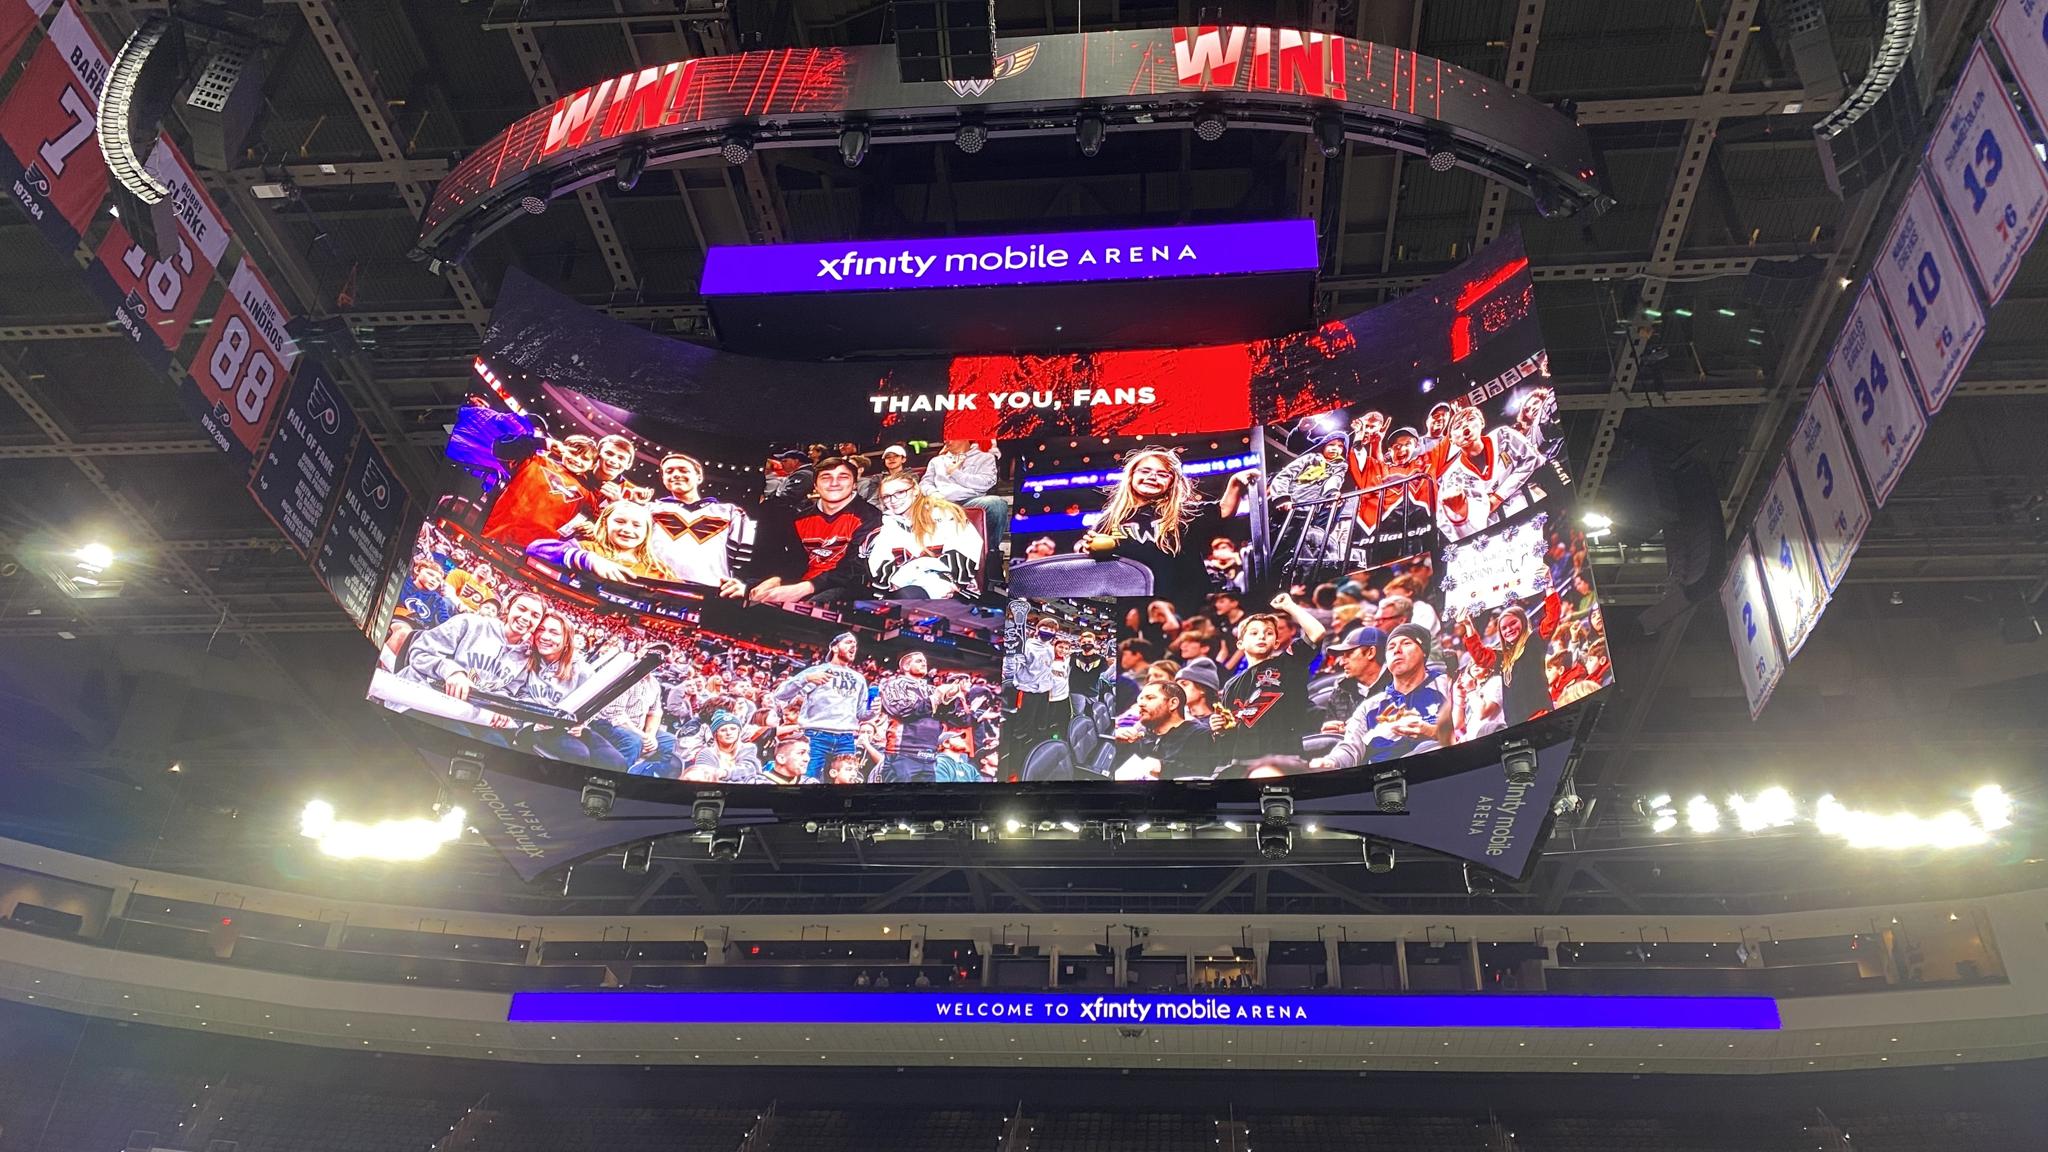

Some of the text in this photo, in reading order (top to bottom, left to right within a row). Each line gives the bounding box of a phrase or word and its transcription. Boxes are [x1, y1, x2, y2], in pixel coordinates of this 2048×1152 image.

[71, 45, 105, 99] BARB
[94, 58, 106, 81] BIL
[1172, 25, 1348, 102] WIN!
[543, 58, 699, 155] WIN!
[39, 82, 98, 176] 7
[1963, 128, 2003, 215] 13
[181, 182, 203, 213] BOBBY
[1996, 202, 2017, 242] 76
[817, 245, 1196, 280] xfinity mobile ARENA
[262, 299, 277, 321] ERIC
[1907, 251, 1941, 330] 10
[242, 290, 284, 353] LINDROS
[1935, 325, 1952, 359] 76
[210, 314, 276, 424] 88
[1854, 350, 1889, 426] 34
[870, 387, 1155, 414] THANK YOU, FANS
[287, 407, 335, 476] HALL OF FAME
[1881, 424, 1896, 455] 76
[1816, 452, 1833, 499] 3
[345, 487, 361, 516] HALL
[360, 510, 370, 525] OF
[1779, 534, 1793, 571] 4
[1742, 600, 1757, 643] 2
[513, 800, 551, 839] ARENA
[1468, 795, 1494, 835] ARENA
[1486, 778, 1535, 856] finity mobile
[937, 998, 1306, 1021] WELCOME TO xfinity mobile ARENA
